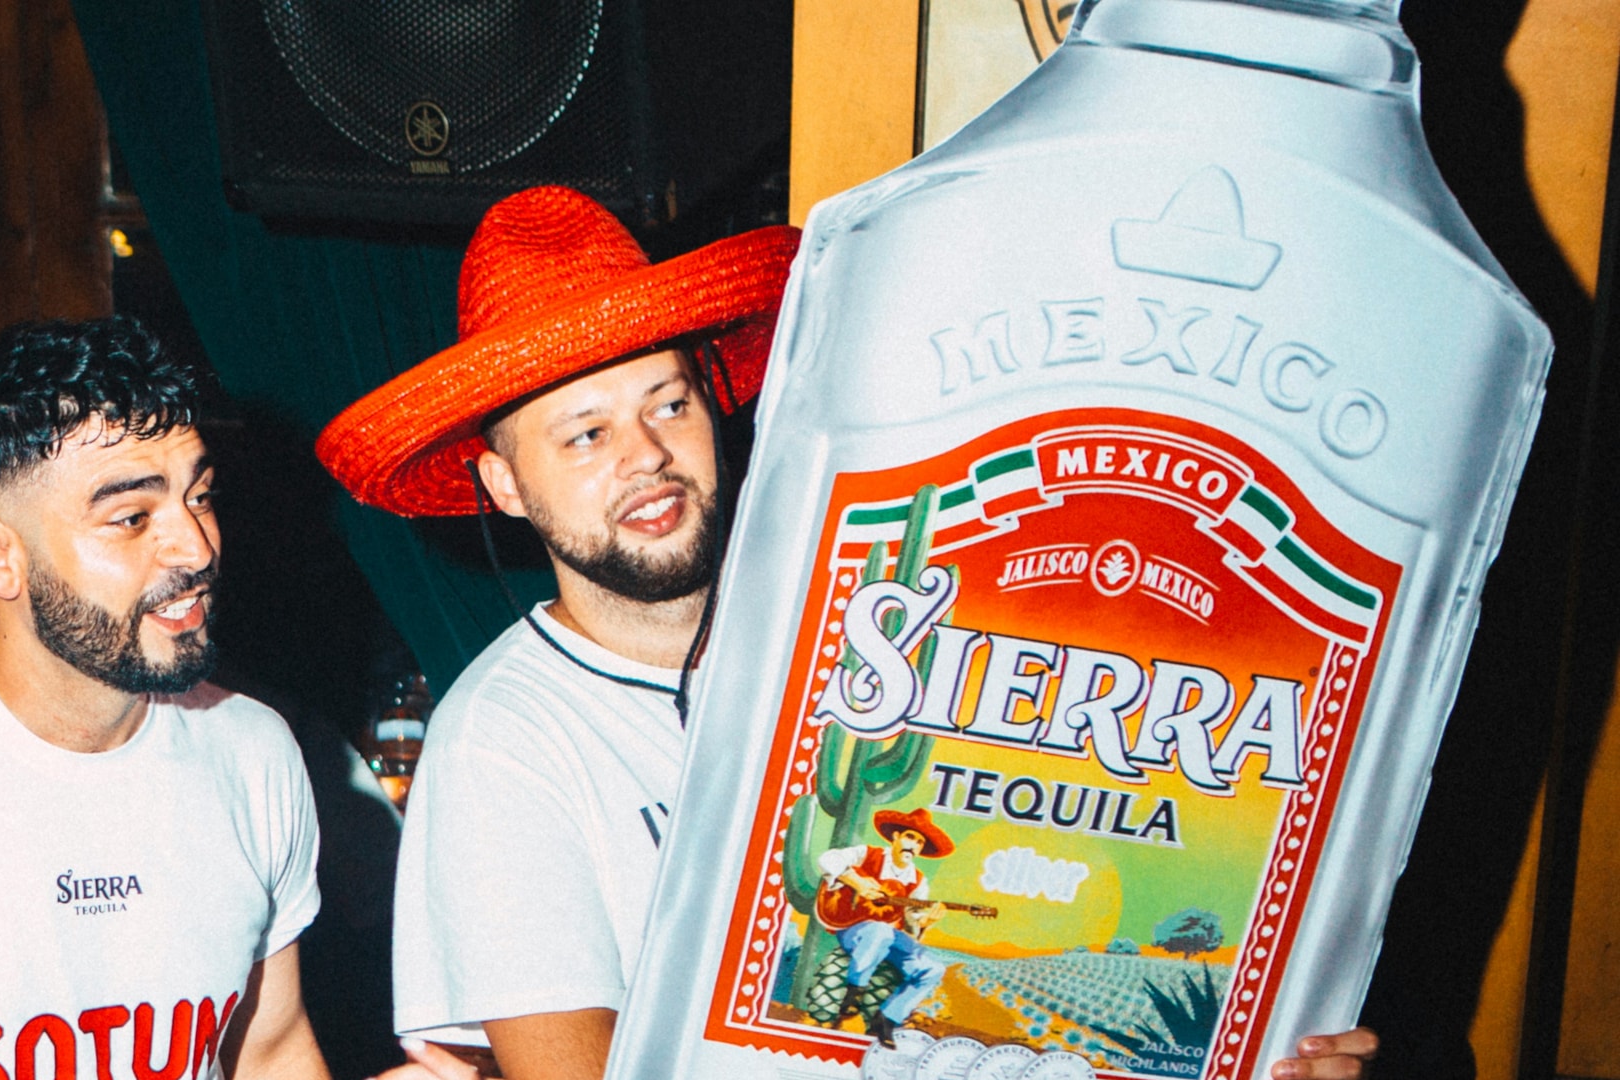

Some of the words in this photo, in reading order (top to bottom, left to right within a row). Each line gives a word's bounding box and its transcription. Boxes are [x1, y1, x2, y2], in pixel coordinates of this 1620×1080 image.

[930, 297, 1388, 459] MEXICO
[1056, 446, 1228, 500] MEXICO
[997, 551, 1088, 586] JALISCO
[1140, 561, 1214, 617] MEXICO
[814, 566, 1308, 796] SIERRA
[931, 763, 1183, 846] TEQUILA
[57, 869, 143, 904] SIERRA
[980, 846, 1090, 903] silver
[74, 903, 127, 915] TEQUILA
[1110, 1054, 1199, 1075] HIGHLANDS
[1139, 1041, 1205, 1058] JALISCO
